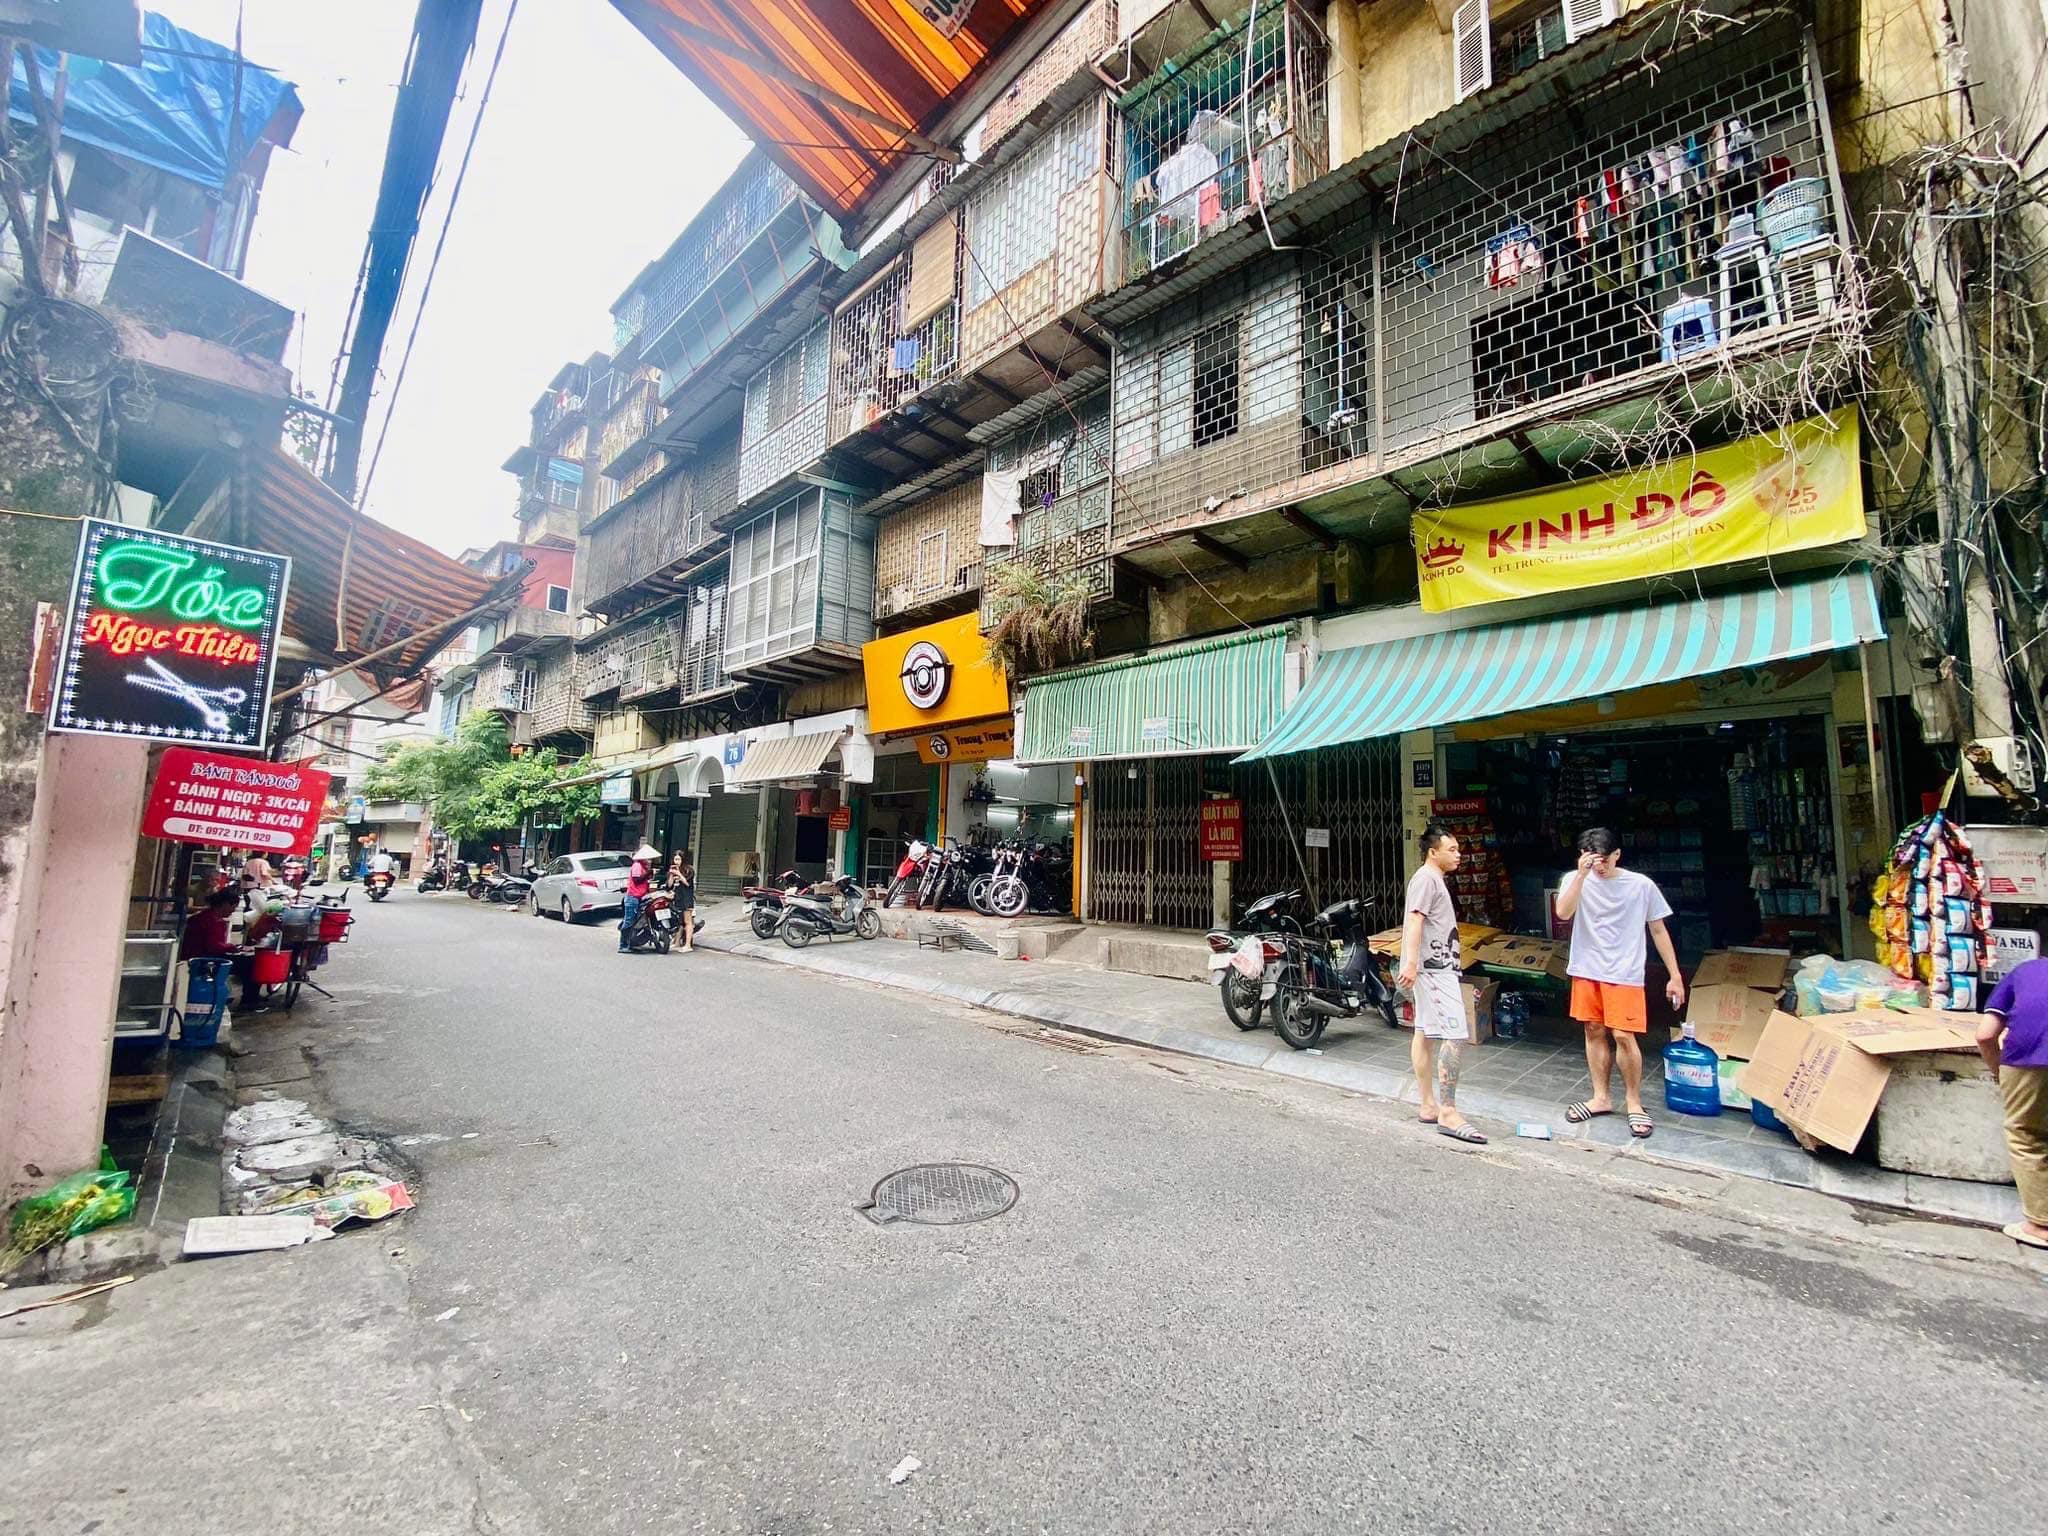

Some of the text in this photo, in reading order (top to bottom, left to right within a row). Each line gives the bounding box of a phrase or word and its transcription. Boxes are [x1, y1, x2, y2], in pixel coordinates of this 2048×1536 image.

[1785, 485, 1818, 508] 25
[1487, 470, 1728, 559] KINH ĐÔ
[1422, 569, 1445, 582] KINH
[85, 613, 258, 666] Ngọc Thiện
[191, 762, 232, 780] BÁNH
[235, 768, 264, 785] RÁN
[179, 782, 312, 812] BÁNH NGỌT: 3K/CÁI
[1445, 802, 1479, 812] ORION
[173, 799, 304, 828] BÁNH MẶN: 3K/CÁI
[205, 826, 230, 837] 0972
[234, 829, 249, 839] 171
[1783, 1060, 1805, 1098] Fairy
